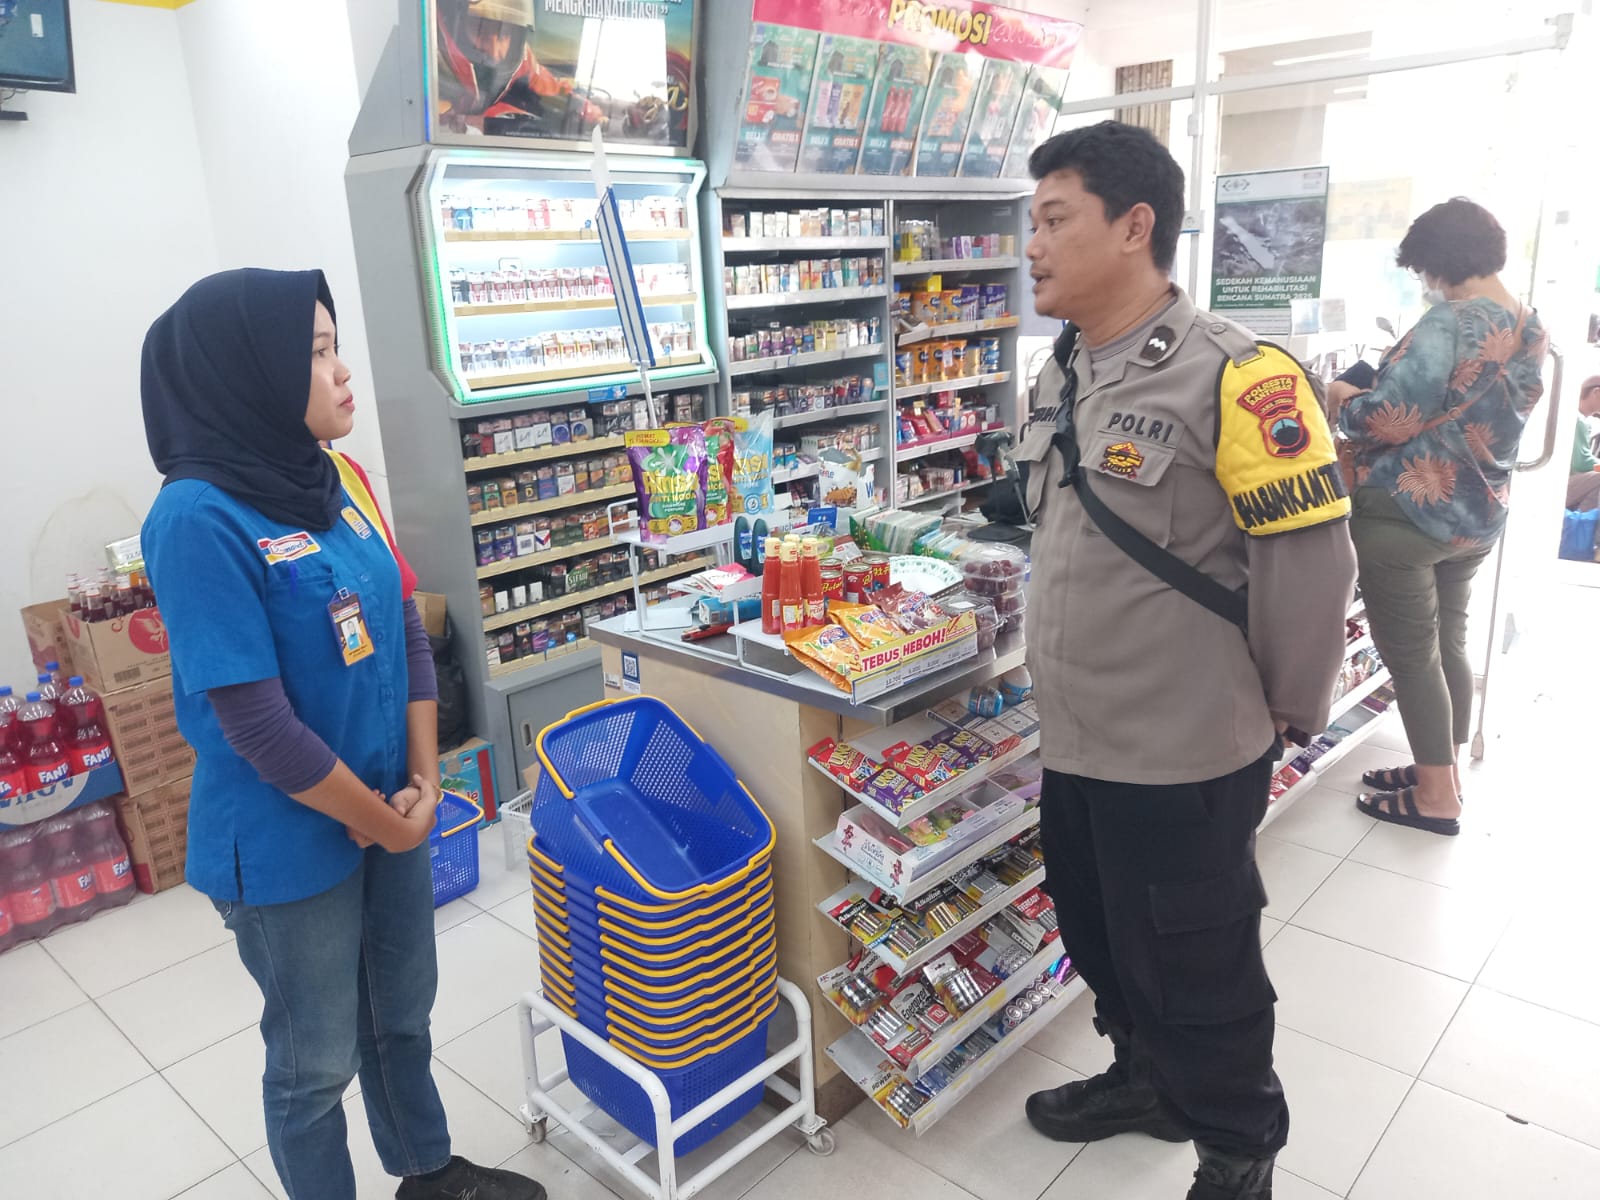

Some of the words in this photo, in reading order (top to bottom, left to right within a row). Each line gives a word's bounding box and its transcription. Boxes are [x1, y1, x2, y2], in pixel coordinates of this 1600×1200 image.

[887, 0, 992, 46] PROMOSI
[1107, 411, 1175, 442] POLRI
[862, 648, 900, 672] TEBUS
[903, 627, 946, 657] HEBOH!
[83, 746, 112, 767] FANT
[38, 762, 69, 784] FANT
[901, 988, 927, 1020] Energizer
